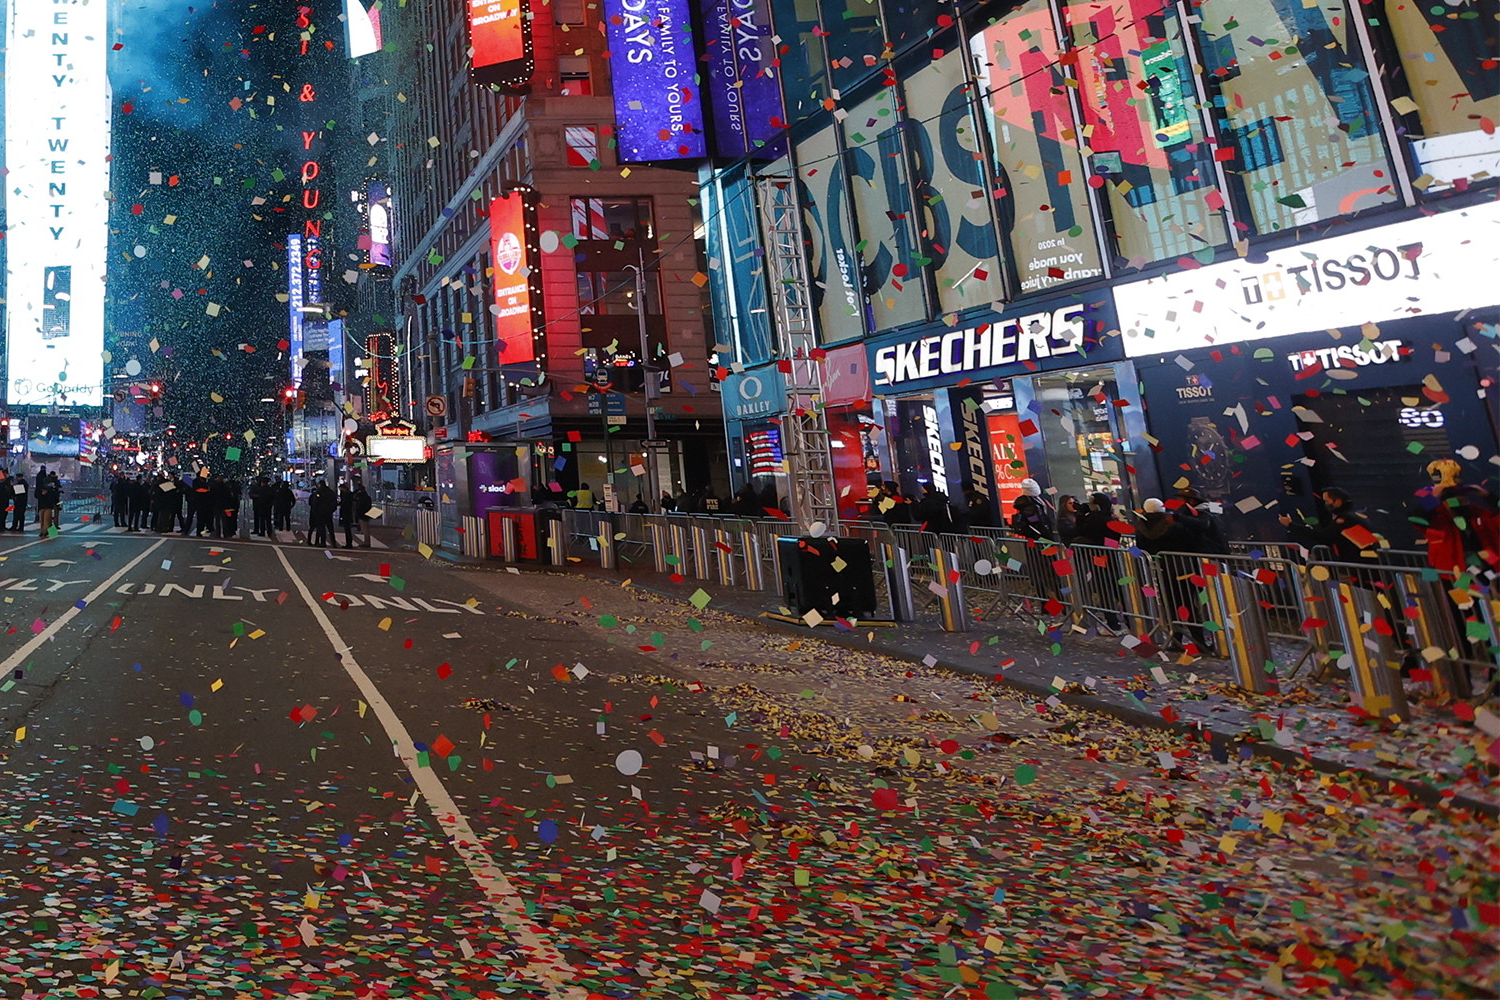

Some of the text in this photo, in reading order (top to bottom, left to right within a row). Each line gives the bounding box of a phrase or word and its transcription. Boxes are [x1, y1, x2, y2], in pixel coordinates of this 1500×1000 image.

[487, 3, 501, 12] ON
[658, 5, 676, 54] FAMILY
[663, 59, 678, 79] TO
[299, 84, 316, 103] &
[47, 116, 69, 241] TWENTY
[301, 131, 323, 272] YOUNG
[1287, 242, 1424, 297] TISSOT
[497, 283, 527, 297] ENTRANCE
[508, 296, 517, 305] ON
[497, 304, 529, 318] ROADWAY
[875, 303, 1084, 386] SKECHERS
[1315, 340, 1402, 370] TISSOT
[36, 382, 94, 396] GoDaddy
[1176, 384, 1213, 399] TISSOT
[736, 401, 771, 416] OAKLEY
[923, 404, 949, 498] SKECHE
[960, 400, 990, 501] SKECH
[993, 443, 1018, 462] ALE
[117, 583, 279, 602] ONLY
[321, 591, 486, 615] ONLY
